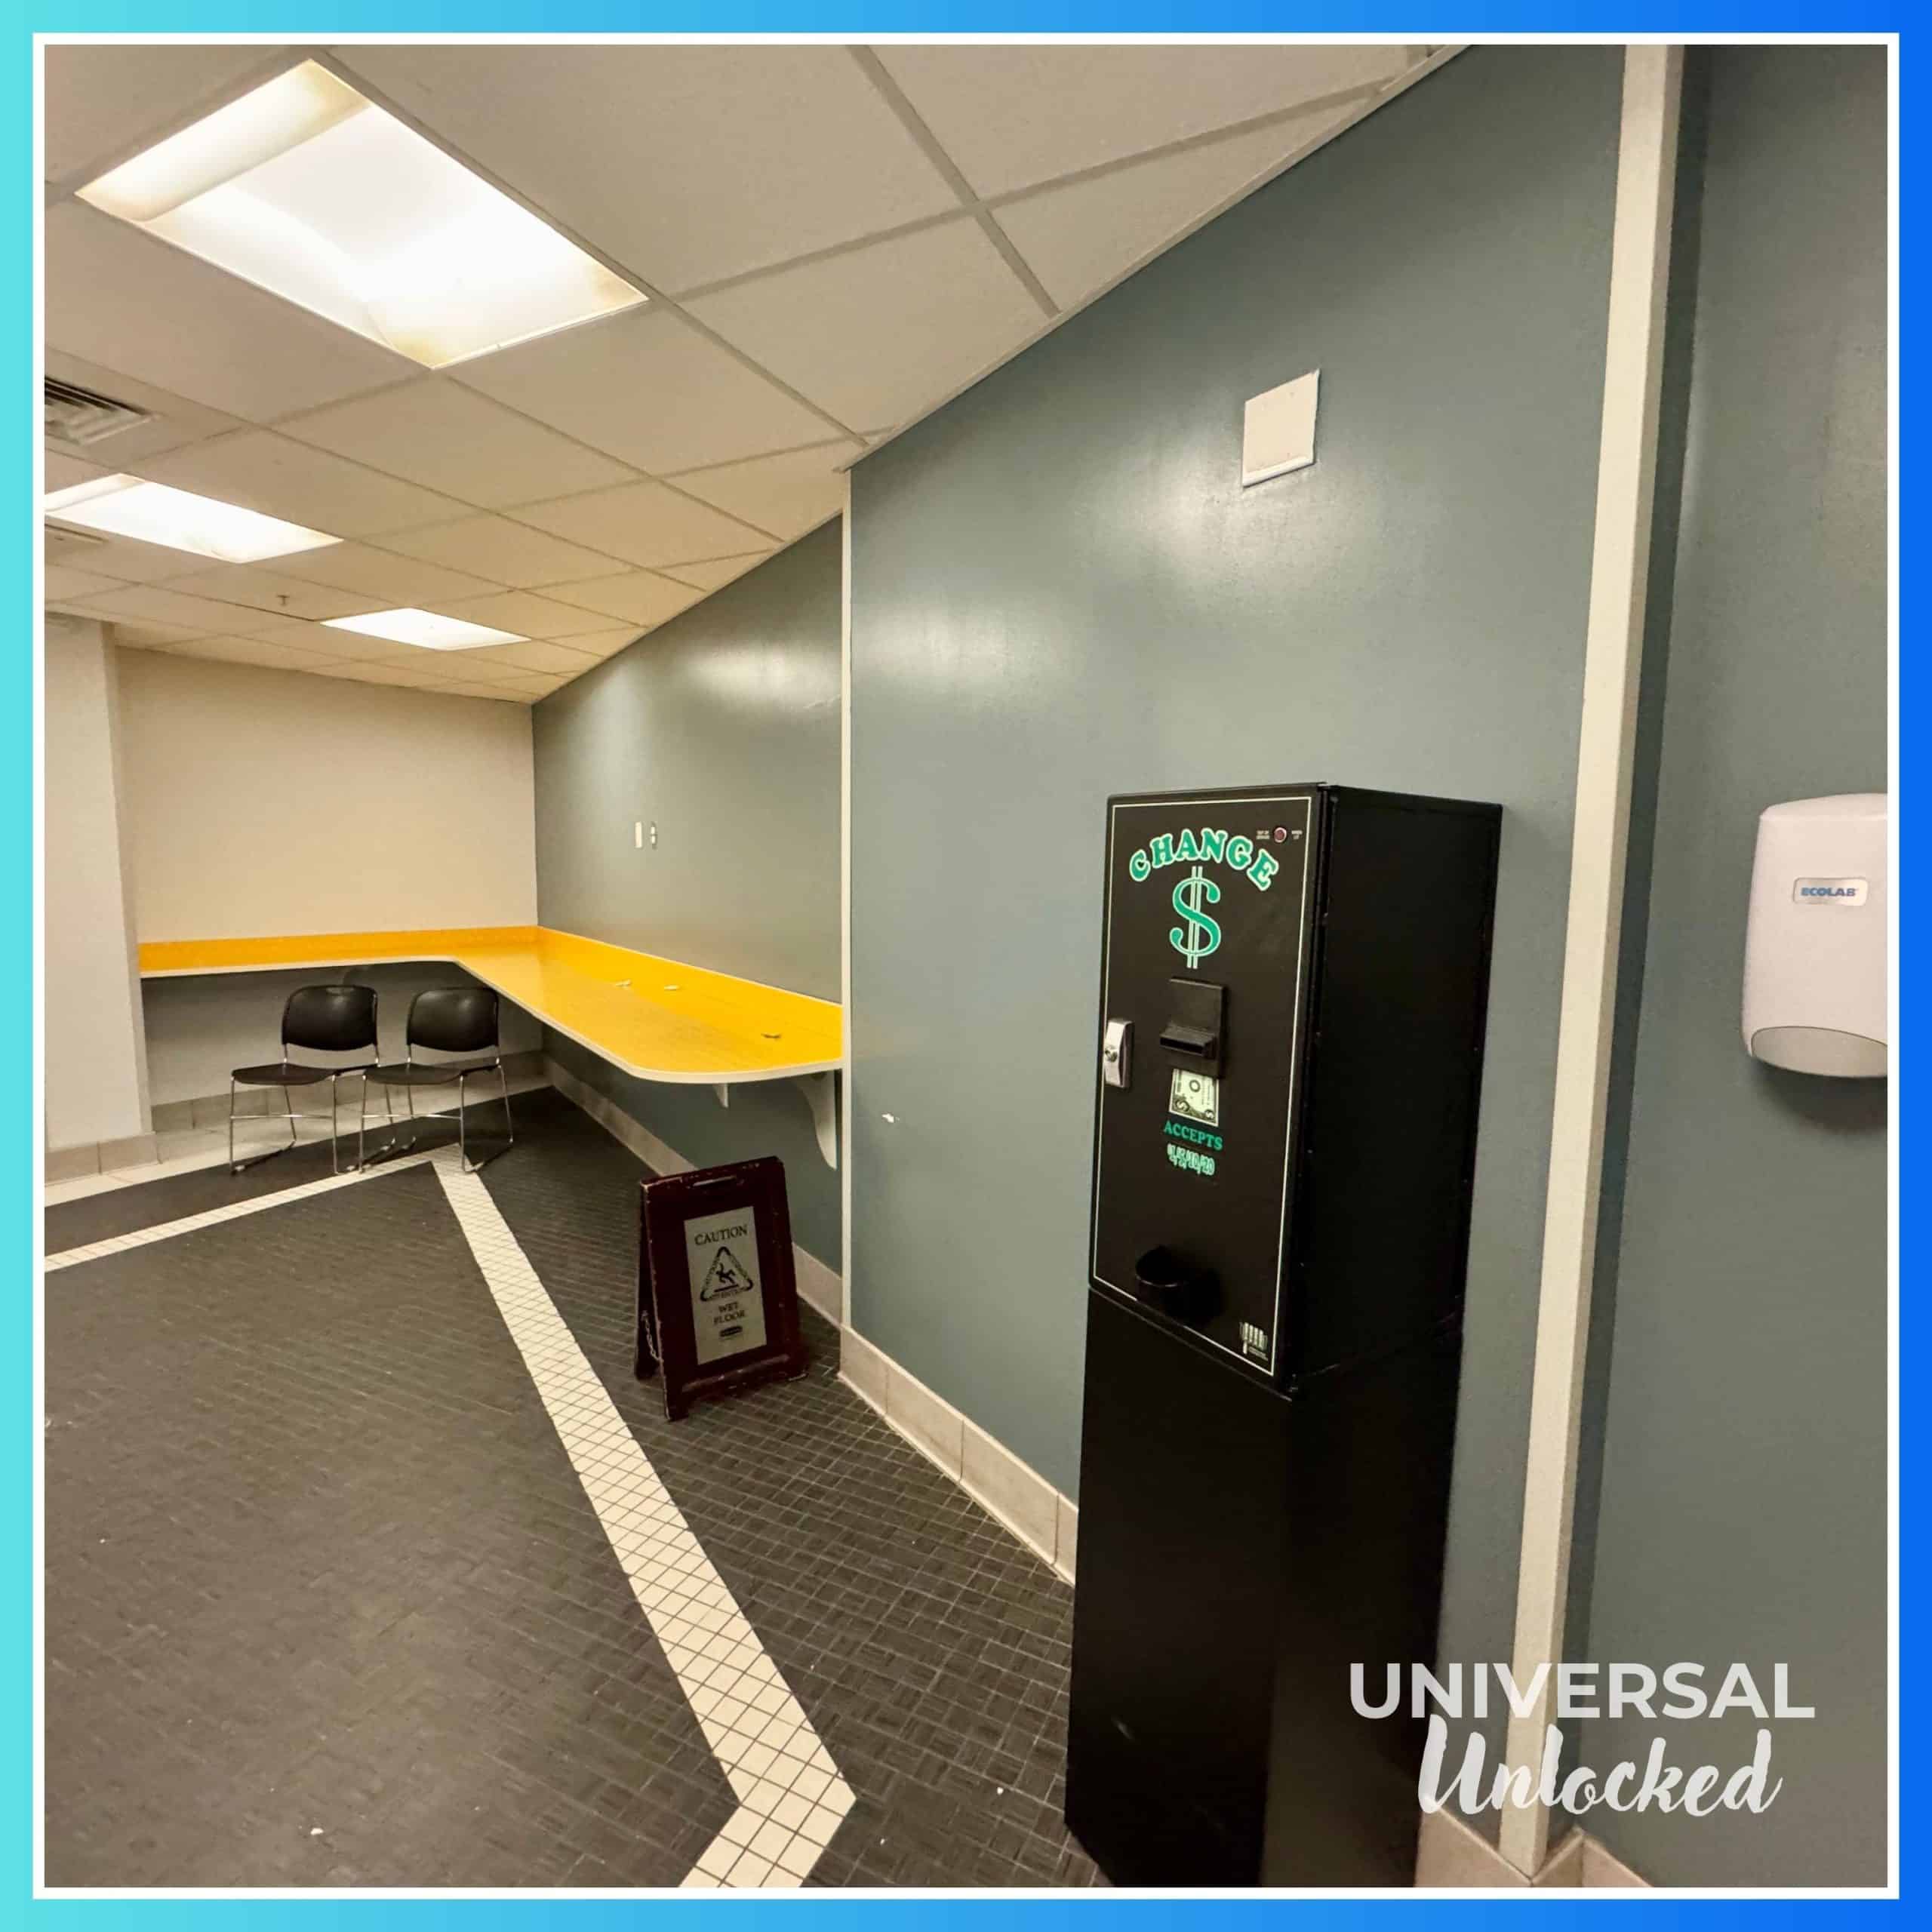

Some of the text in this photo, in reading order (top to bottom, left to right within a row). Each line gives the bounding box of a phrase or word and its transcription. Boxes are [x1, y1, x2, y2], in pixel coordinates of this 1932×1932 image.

[1130, 828, 1278, 891] CHANGE
[1801, 888, 1856, 897] ECOLAB
[1170, 866, 1221, 969] $
[1164, 1120, 1223, 1151] ACCEPTS
[694, 1225, 748, 1245] CAUTION
[713, 1309, 745, 1326] FLOOR
[718, 1302, 738, 1313] WET
